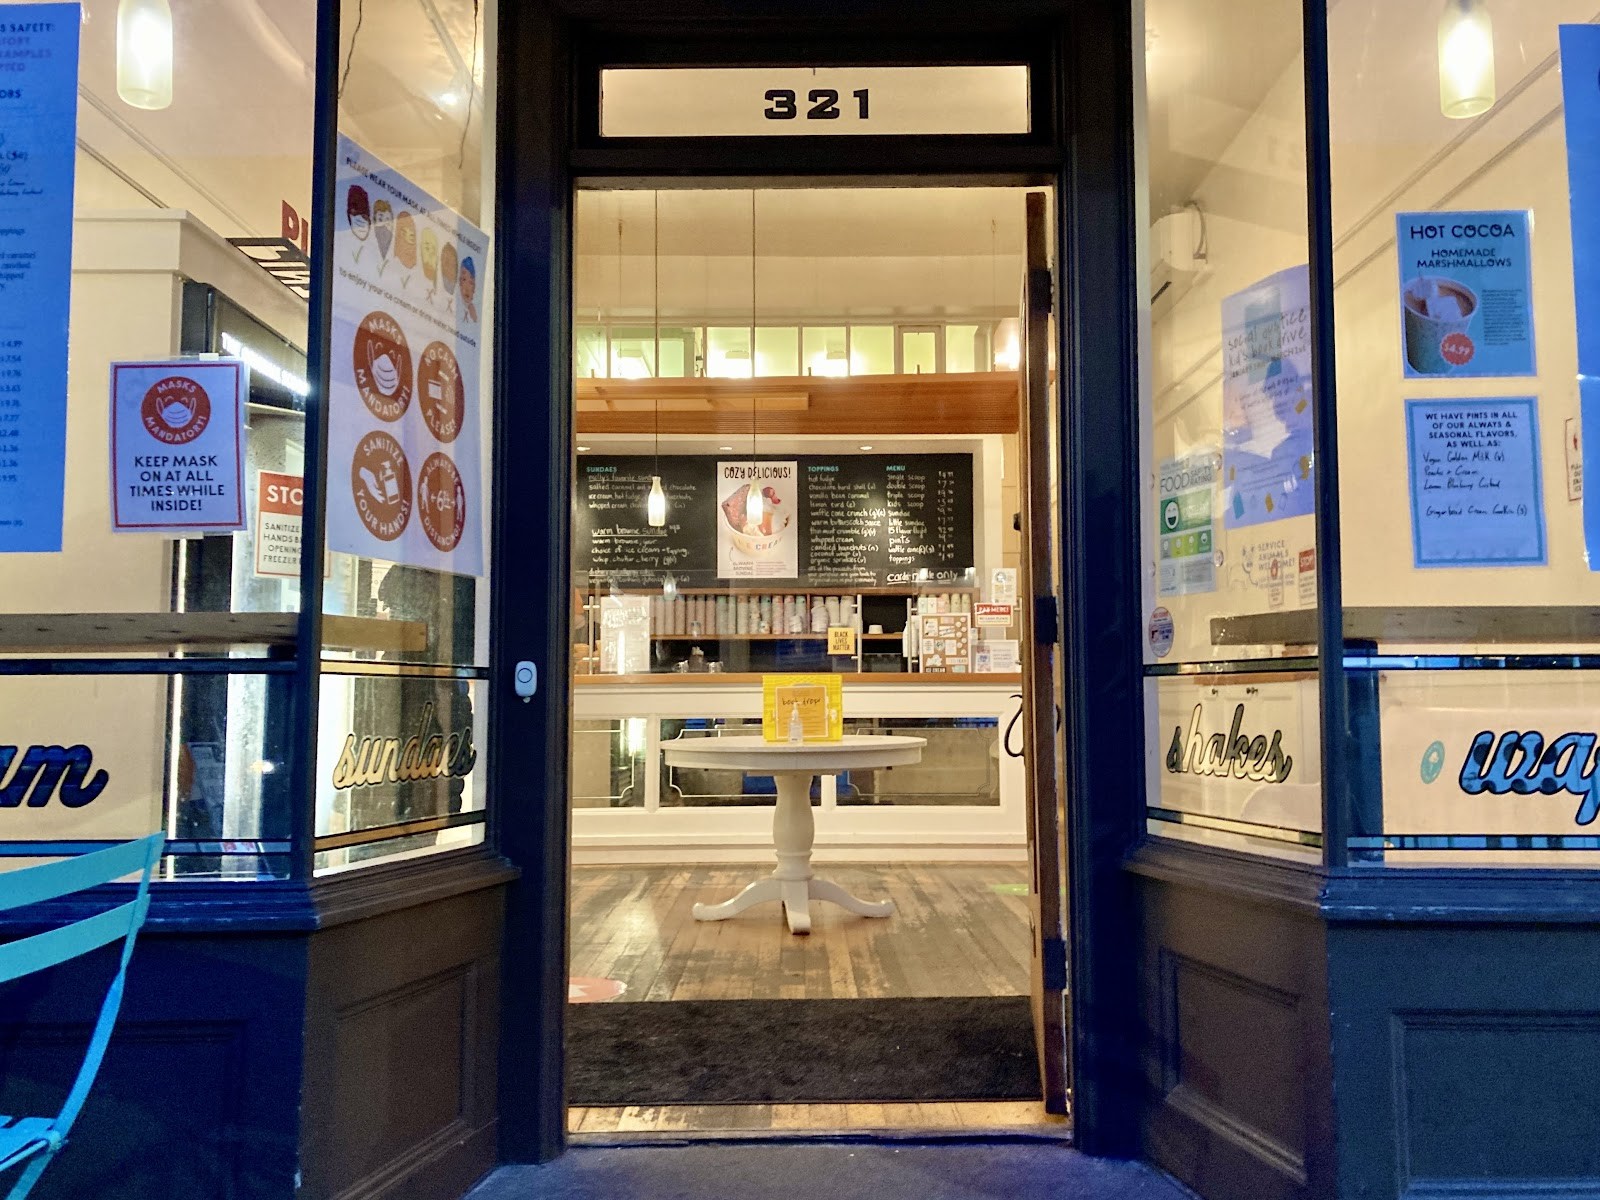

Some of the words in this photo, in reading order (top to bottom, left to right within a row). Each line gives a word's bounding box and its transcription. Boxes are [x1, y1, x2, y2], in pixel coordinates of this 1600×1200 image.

[764, 89, 868, 119] 321
[1410, 225, 1445, 240] HOT
[1451, 224, 1515, 238] COCOA
[1431, 248, 1496, 258] HOMEMADE
[1417, 258, 1512, 268] MARSHMALLOWS
[157, 380, 197, 394] MASKS
[1440, 412, 1463, 420] HAVE
[145, 415, 207, 442] MANDATORY!
[1506, 420, 1512, 428] &
[1446, 440, 1457, 448] AS
[1460, 440, 1483, 448] WELL
[135, 456, 169, 468] KEEP
[173, 456, 218, 466] MASK
[140, 471, 162, 482] ON
[166, 471, 181, 482] AT
[186, 470, 214, 482] ALL
[724, 467, 746, 479] COZY
[748, 467, 792, 478] DELICIOUS!
[1160, 472, 1190, 494] FOOD
[130, 486, 172, 497] TIMES
[177, 485, 225, 496] WHILE
[151, 500, 202, 511] INSIDE!
[265, 522, 299, 533] SANITIZE
[263, 533, 293, 544] HANDS
[888, 535, 911, 547] pints
[263, 554, 297, 564] FREEZER
[888, 554, 916, 564] toppings
[936, 571, 958, 582] only
[333, 702, 478, 790] sundaes
[1166, 703, 1294, 784] shakes
